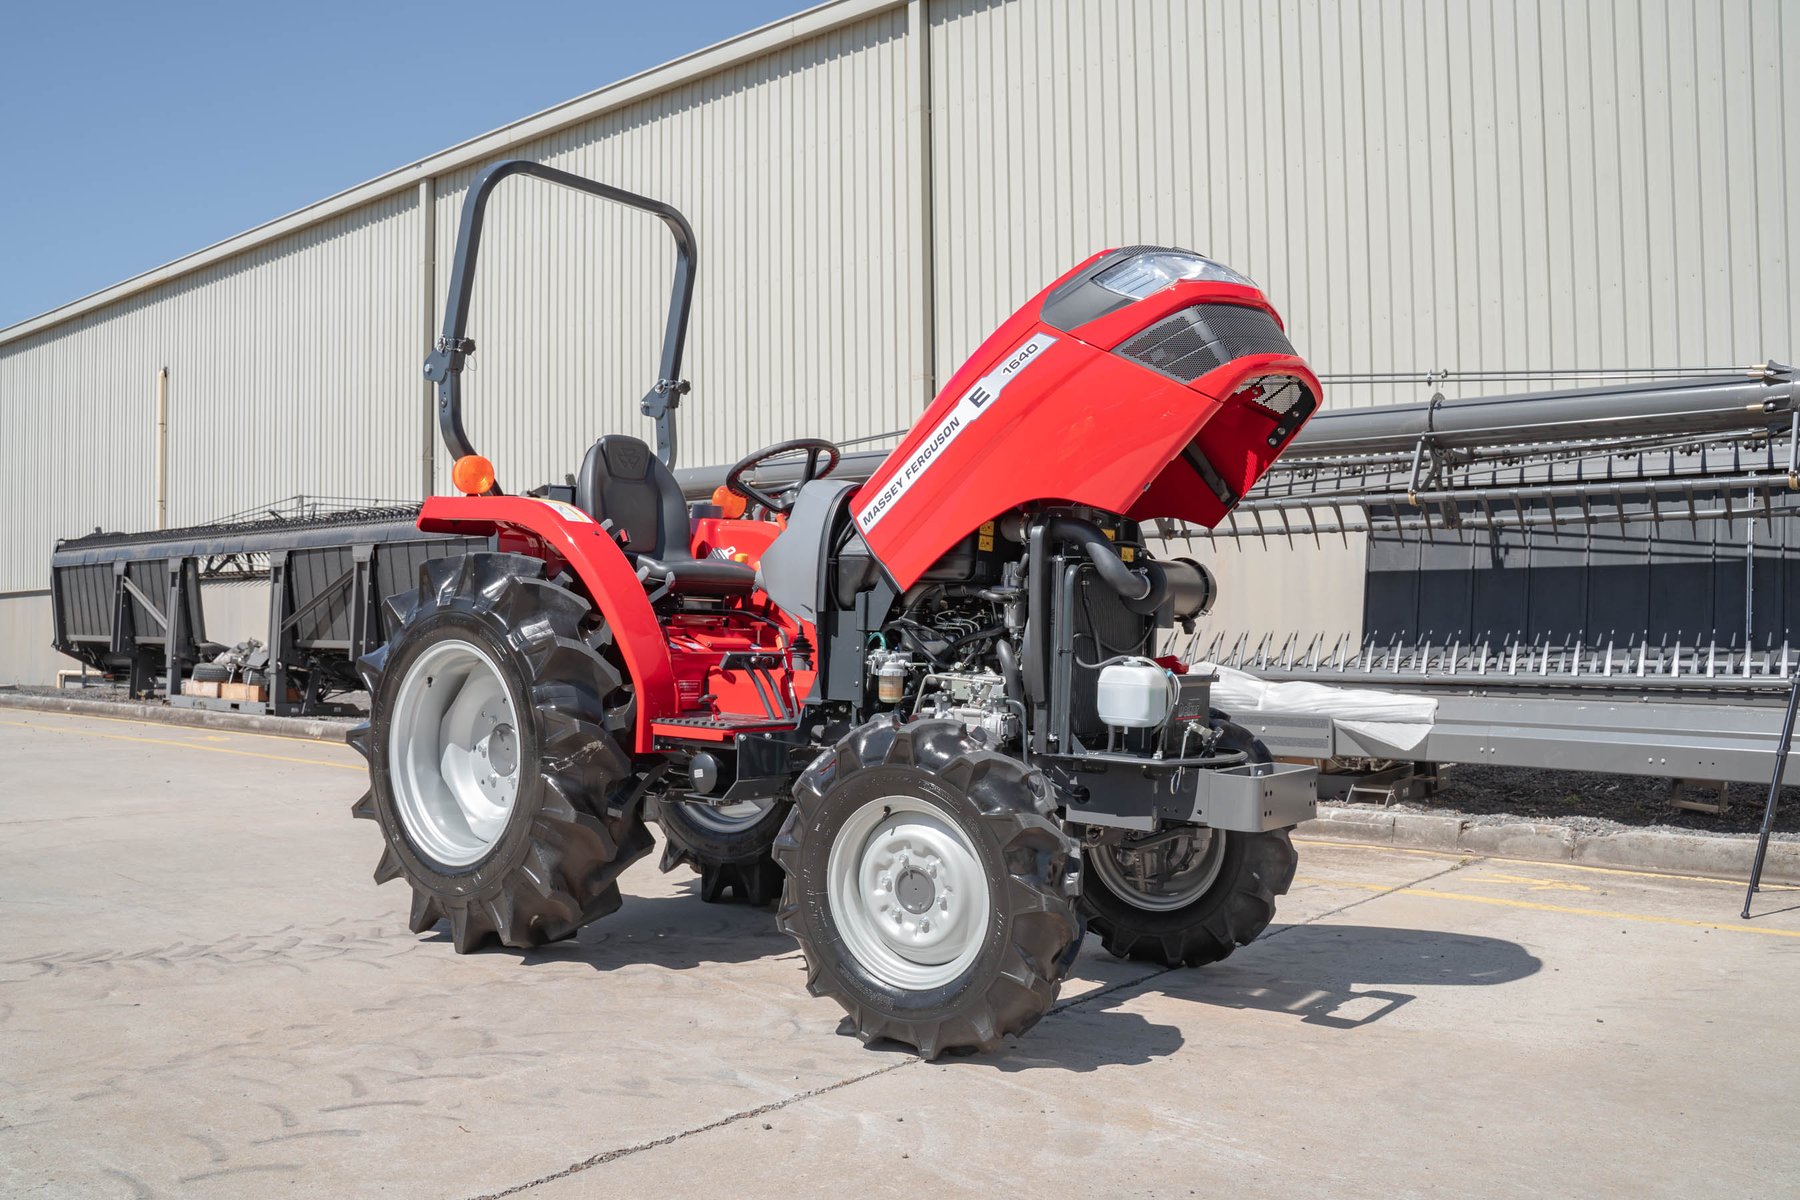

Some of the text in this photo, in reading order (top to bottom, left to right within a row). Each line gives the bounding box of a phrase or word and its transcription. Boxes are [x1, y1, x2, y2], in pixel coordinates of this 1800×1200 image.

[862, 342, 1039, 526] MASSEY FERGUSON E 1640
